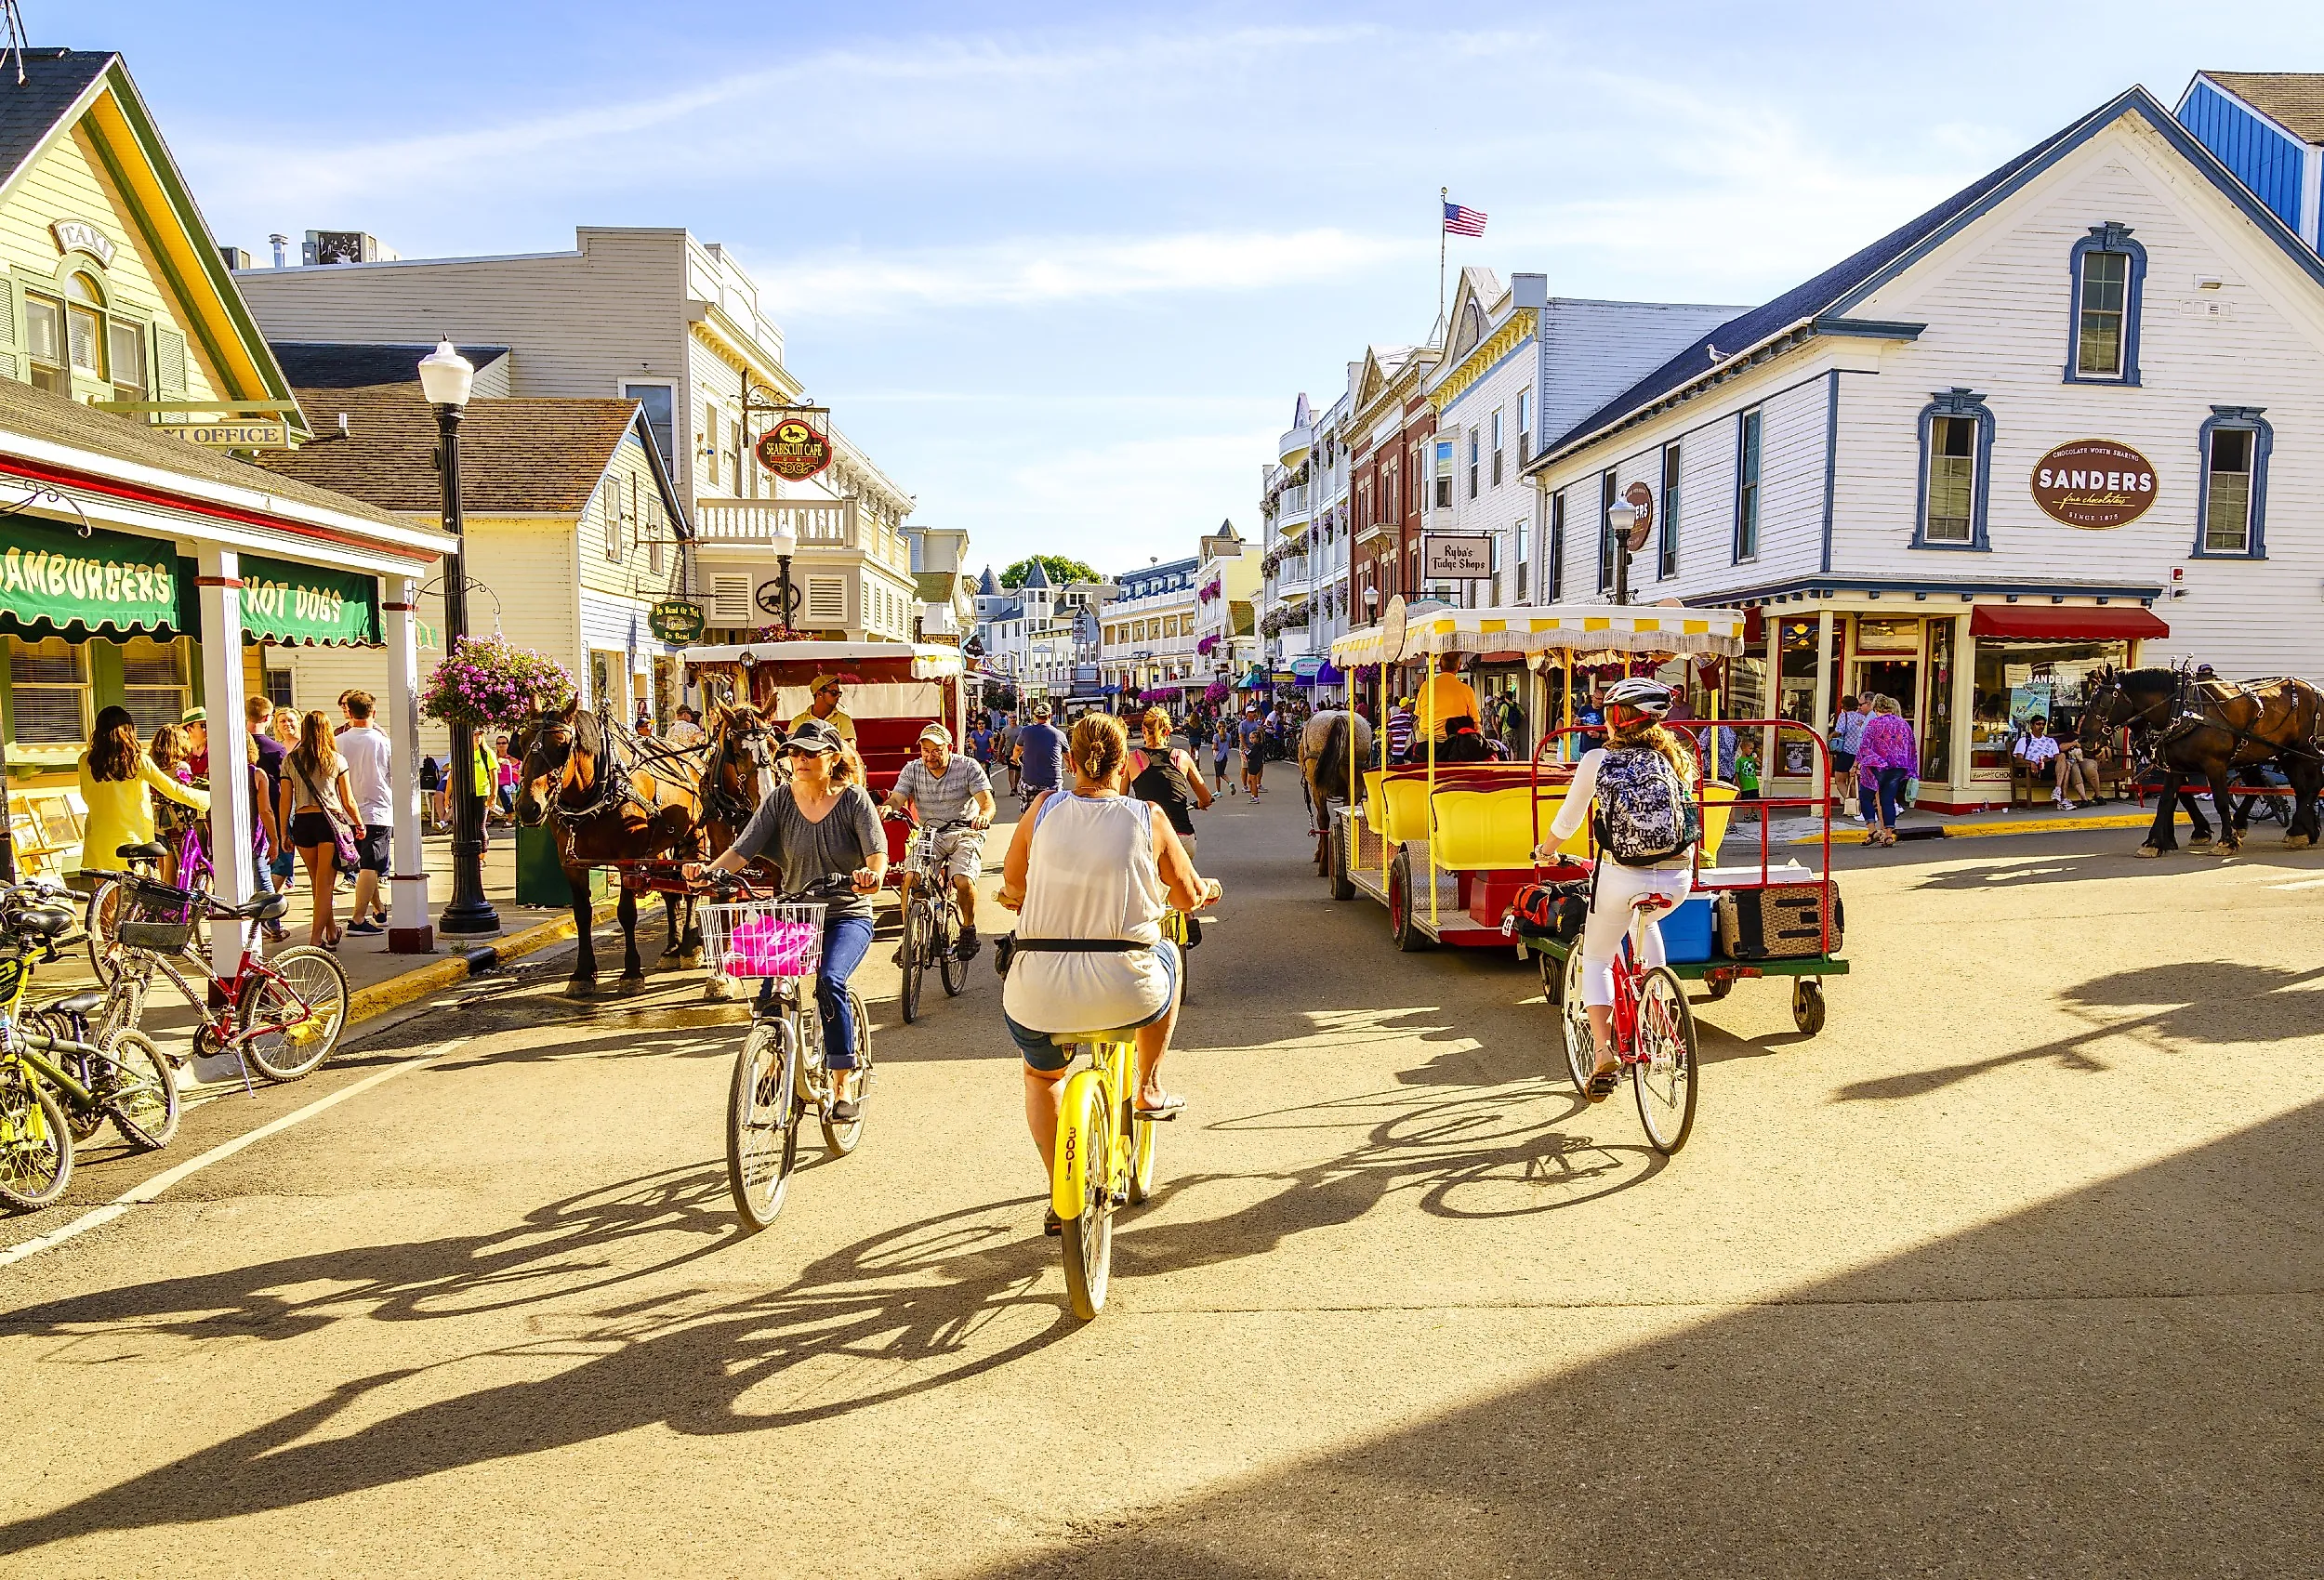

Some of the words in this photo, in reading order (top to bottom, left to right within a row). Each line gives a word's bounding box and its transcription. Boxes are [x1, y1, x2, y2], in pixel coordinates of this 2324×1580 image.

[61, 225, 110, 258] TAXI
[193, 428, 279, 443] OFFICE
[766, 441, 803, 456] SEABISCUIT
[804, 441, 823, 457] CAFÉ
[2053, 447, 2088, 459] CHOCOLATE
[2090, 447, 2111, 456] WORTH
[2112, 449, 2139, 462] SHARING
[2039, 468, 2152, 493] SANDERS
[2068, 511, 2095, 521] SINCE
[2099, 513, 2119, 521] 1875
[1444, 544, 1474, 560] Ryba's
[1459, 558, 1486, 572] Shops
[0, 546, 170, 604] AMBURGERS
[244, 575, 289, 619] HOT
[295, 584, 344, 624] DOGS
[665, 605, 679, 614] Bead
[664, 631, 673, 639] To
[675, 632, 690, 640] Bead
[1065, 1126, 1076, 1175] 3001
